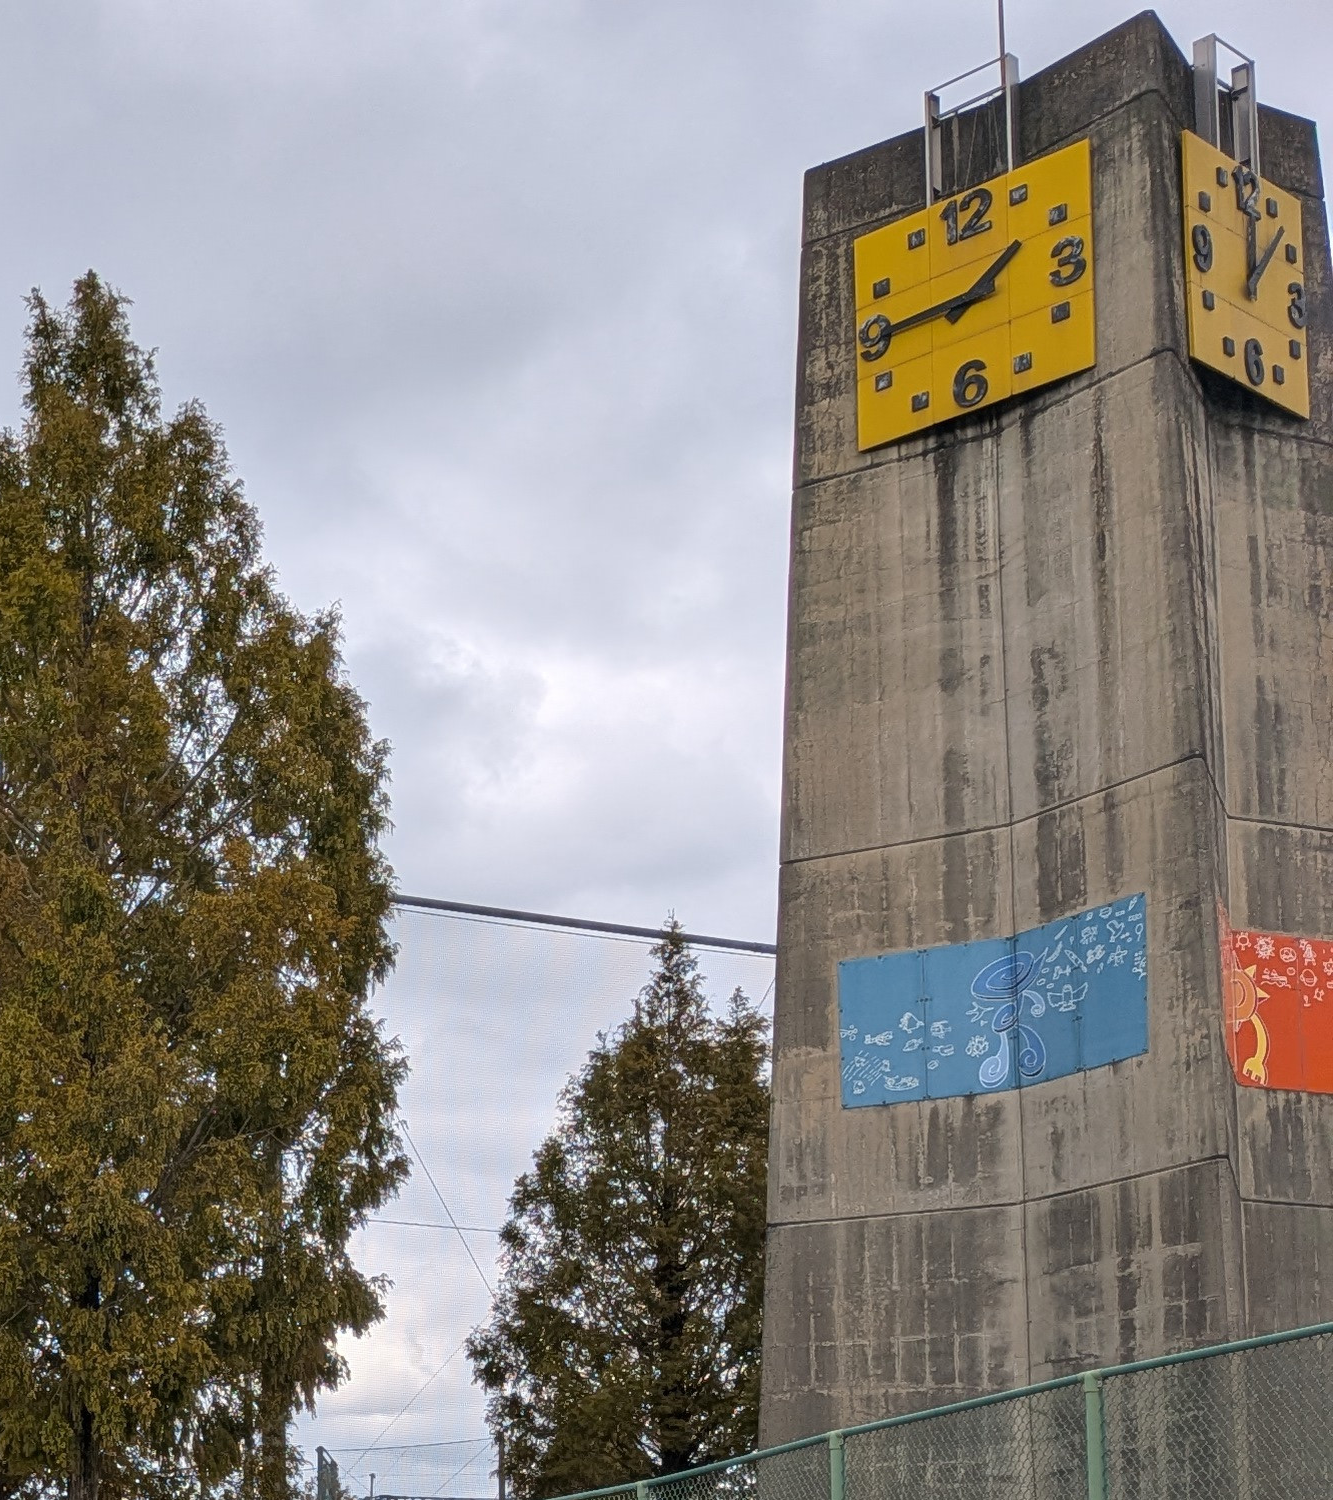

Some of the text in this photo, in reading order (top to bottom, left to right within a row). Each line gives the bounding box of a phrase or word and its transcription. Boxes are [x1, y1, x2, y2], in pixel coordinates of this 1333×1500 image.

[939, 188, 993, 246] 12
[1232, 165, 1261, 221] 12
[1048, 236, 1087, 287] 3
[1192, 224, 1213, 272] 9
[1287, 281, 1307, 329] 3
[858, 314, 891, 362] 9
[1244, 338, 1264, 386] 6
[952, 359, 989, 408] 6
